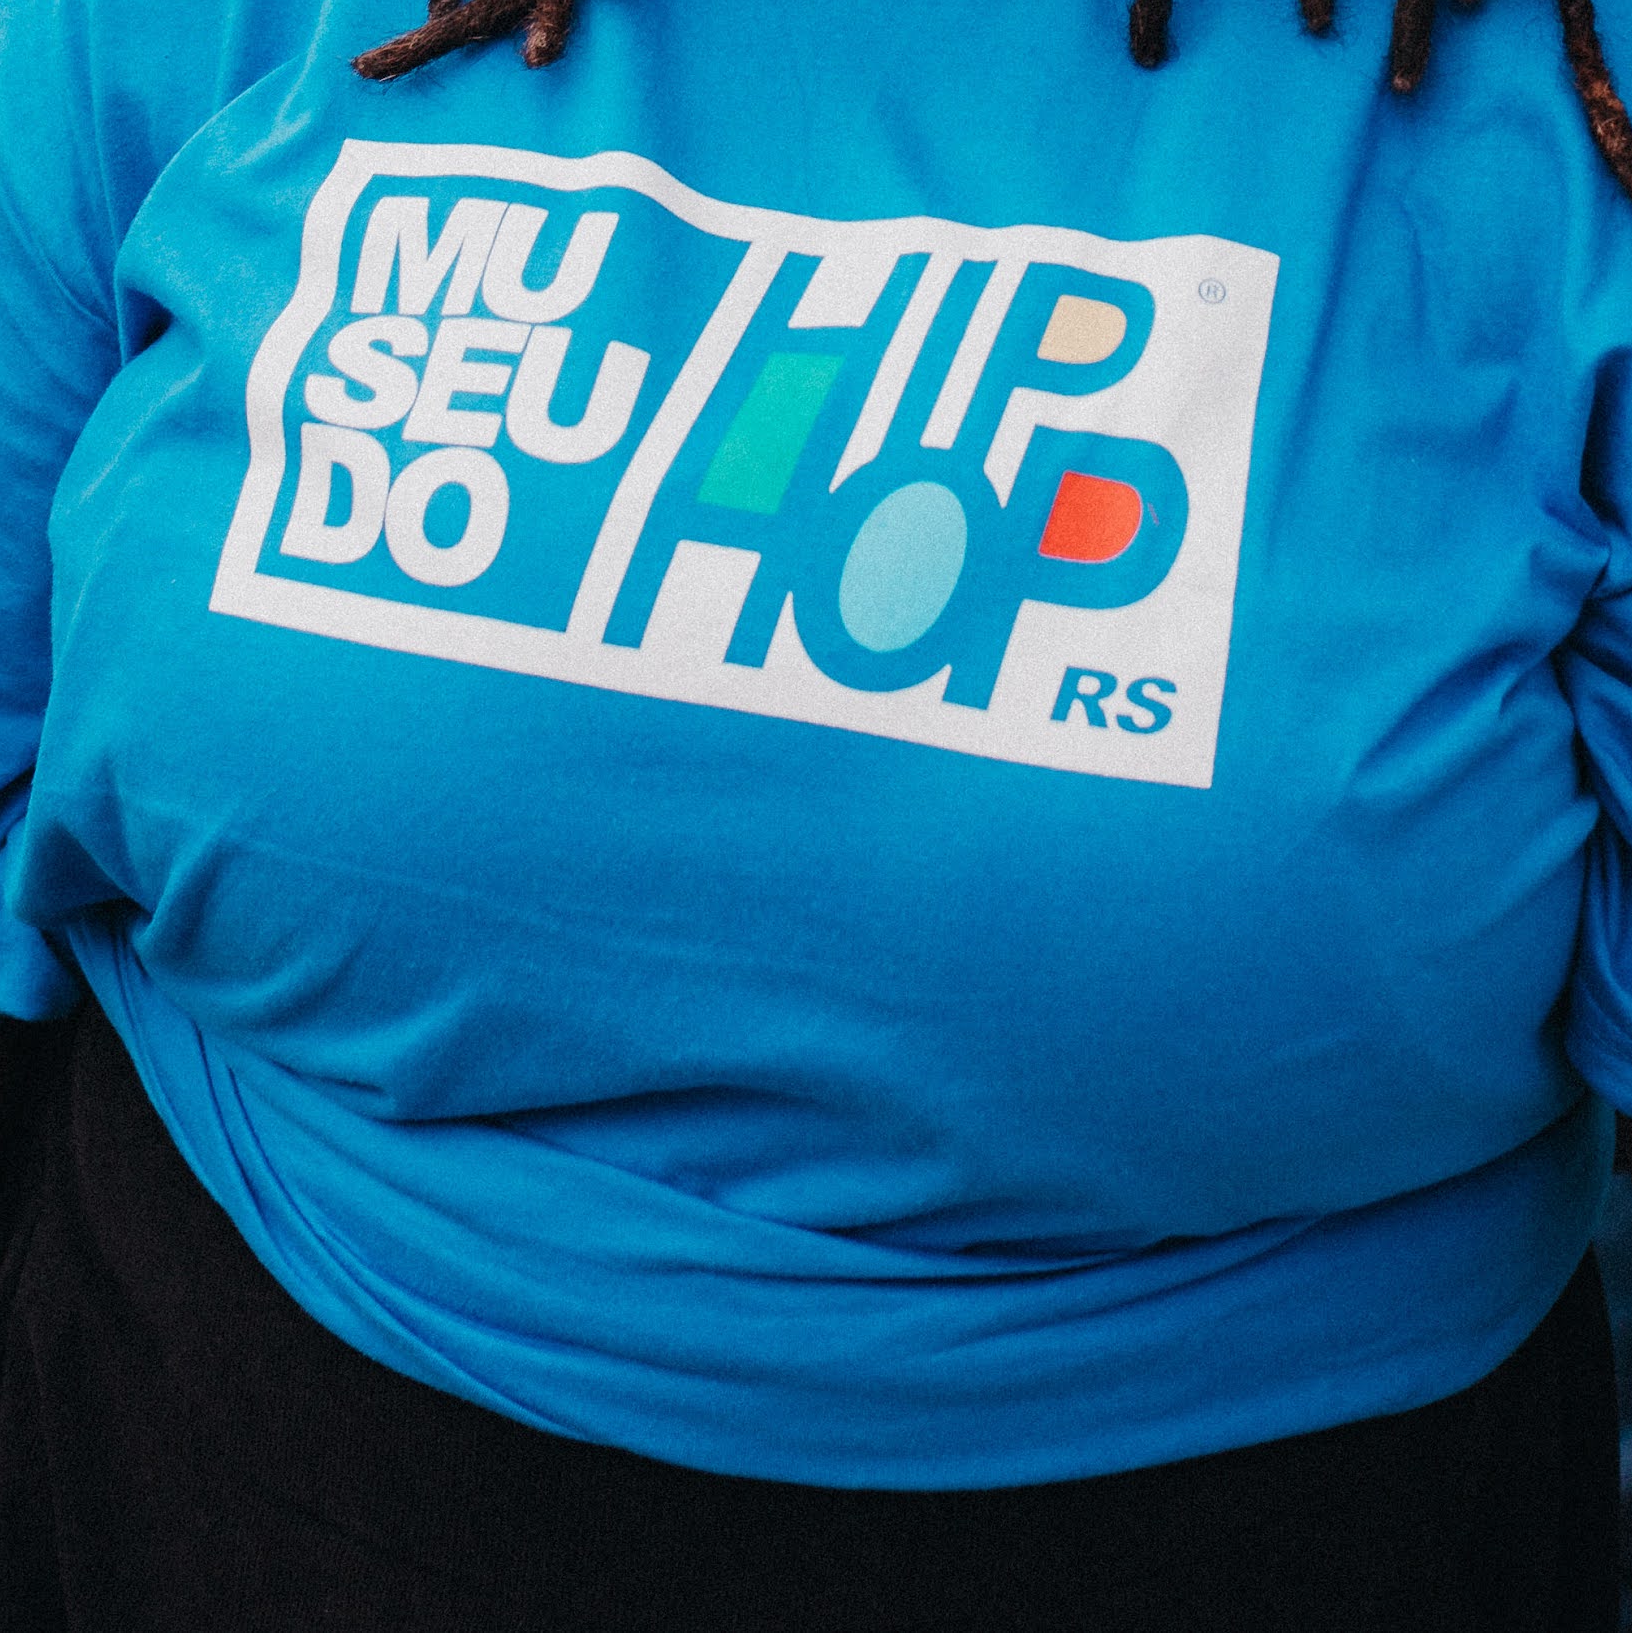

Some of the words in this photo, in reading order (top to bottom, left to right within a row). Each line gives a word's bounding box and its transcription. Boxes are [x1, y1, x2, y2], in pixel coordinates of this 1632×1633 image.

[350, 196, 619, 323] MU
[305, 317, 651, 464] SEU
[675, 251, 1157, 477] HIP
[279, 422, 510, 587] DO
[601, 424, 1190, 711] HOP
[1050, 666, 1178, 735] RS
